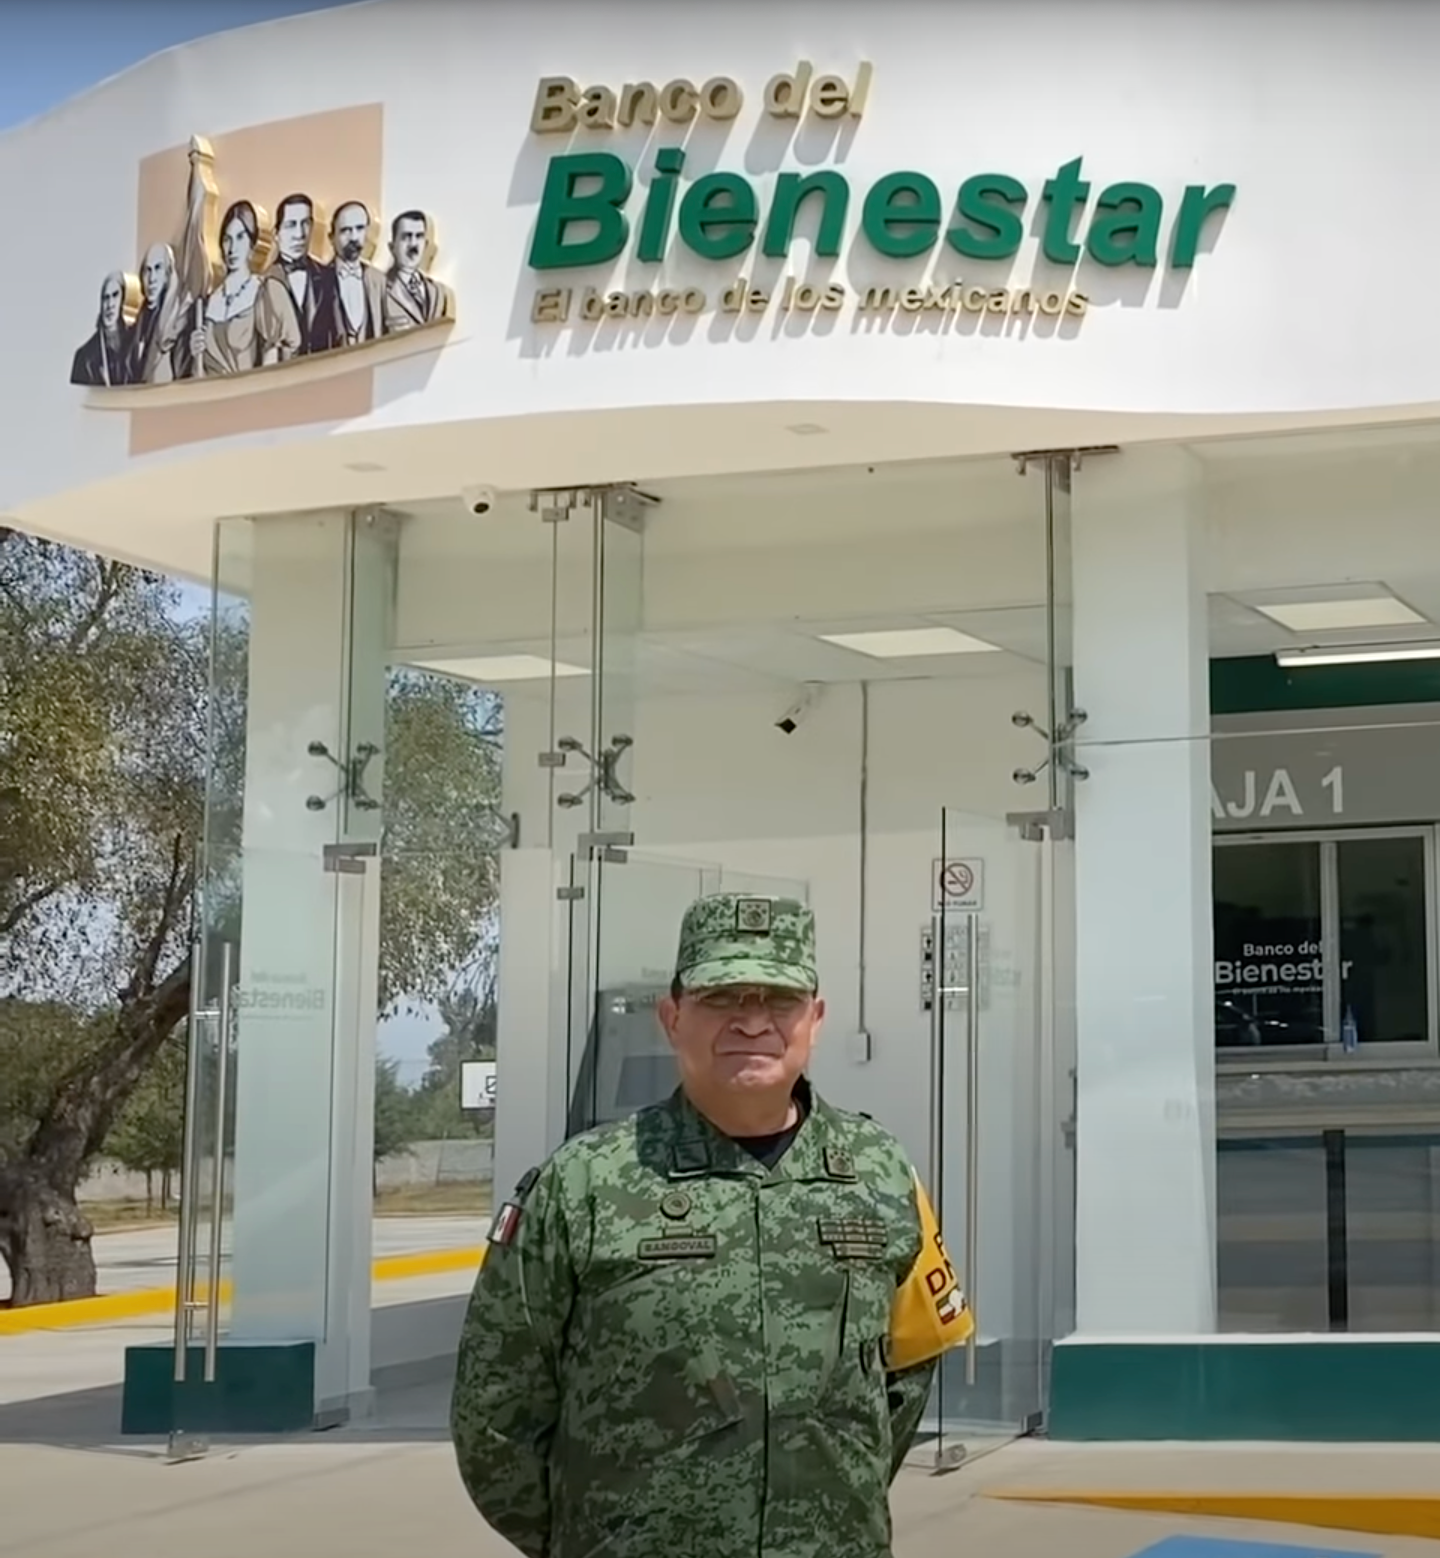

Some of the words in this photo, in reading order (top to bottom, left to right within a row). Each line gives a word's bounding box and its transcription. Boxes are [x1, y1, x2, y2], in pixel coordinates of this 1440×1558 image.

[529, 74, 742, 134] Banco
[764, 60, 872, 119] del
[528, 147, 1237, 270] Bienestar
[531, 288, 571, 323] El
[580, 284, 706, 321] banco
[720, 277, 769, 313] de
[782, 275, 845, 312] los
[858, 279, 1089, 315] mexicanos
[1321, 765, 1343, 813] 1
[1214, 958, 1353, 984] Bienestr
[1243, 943, 1294, 957] Banco
[644, 1240, 711, 1253] SANDOVAL
